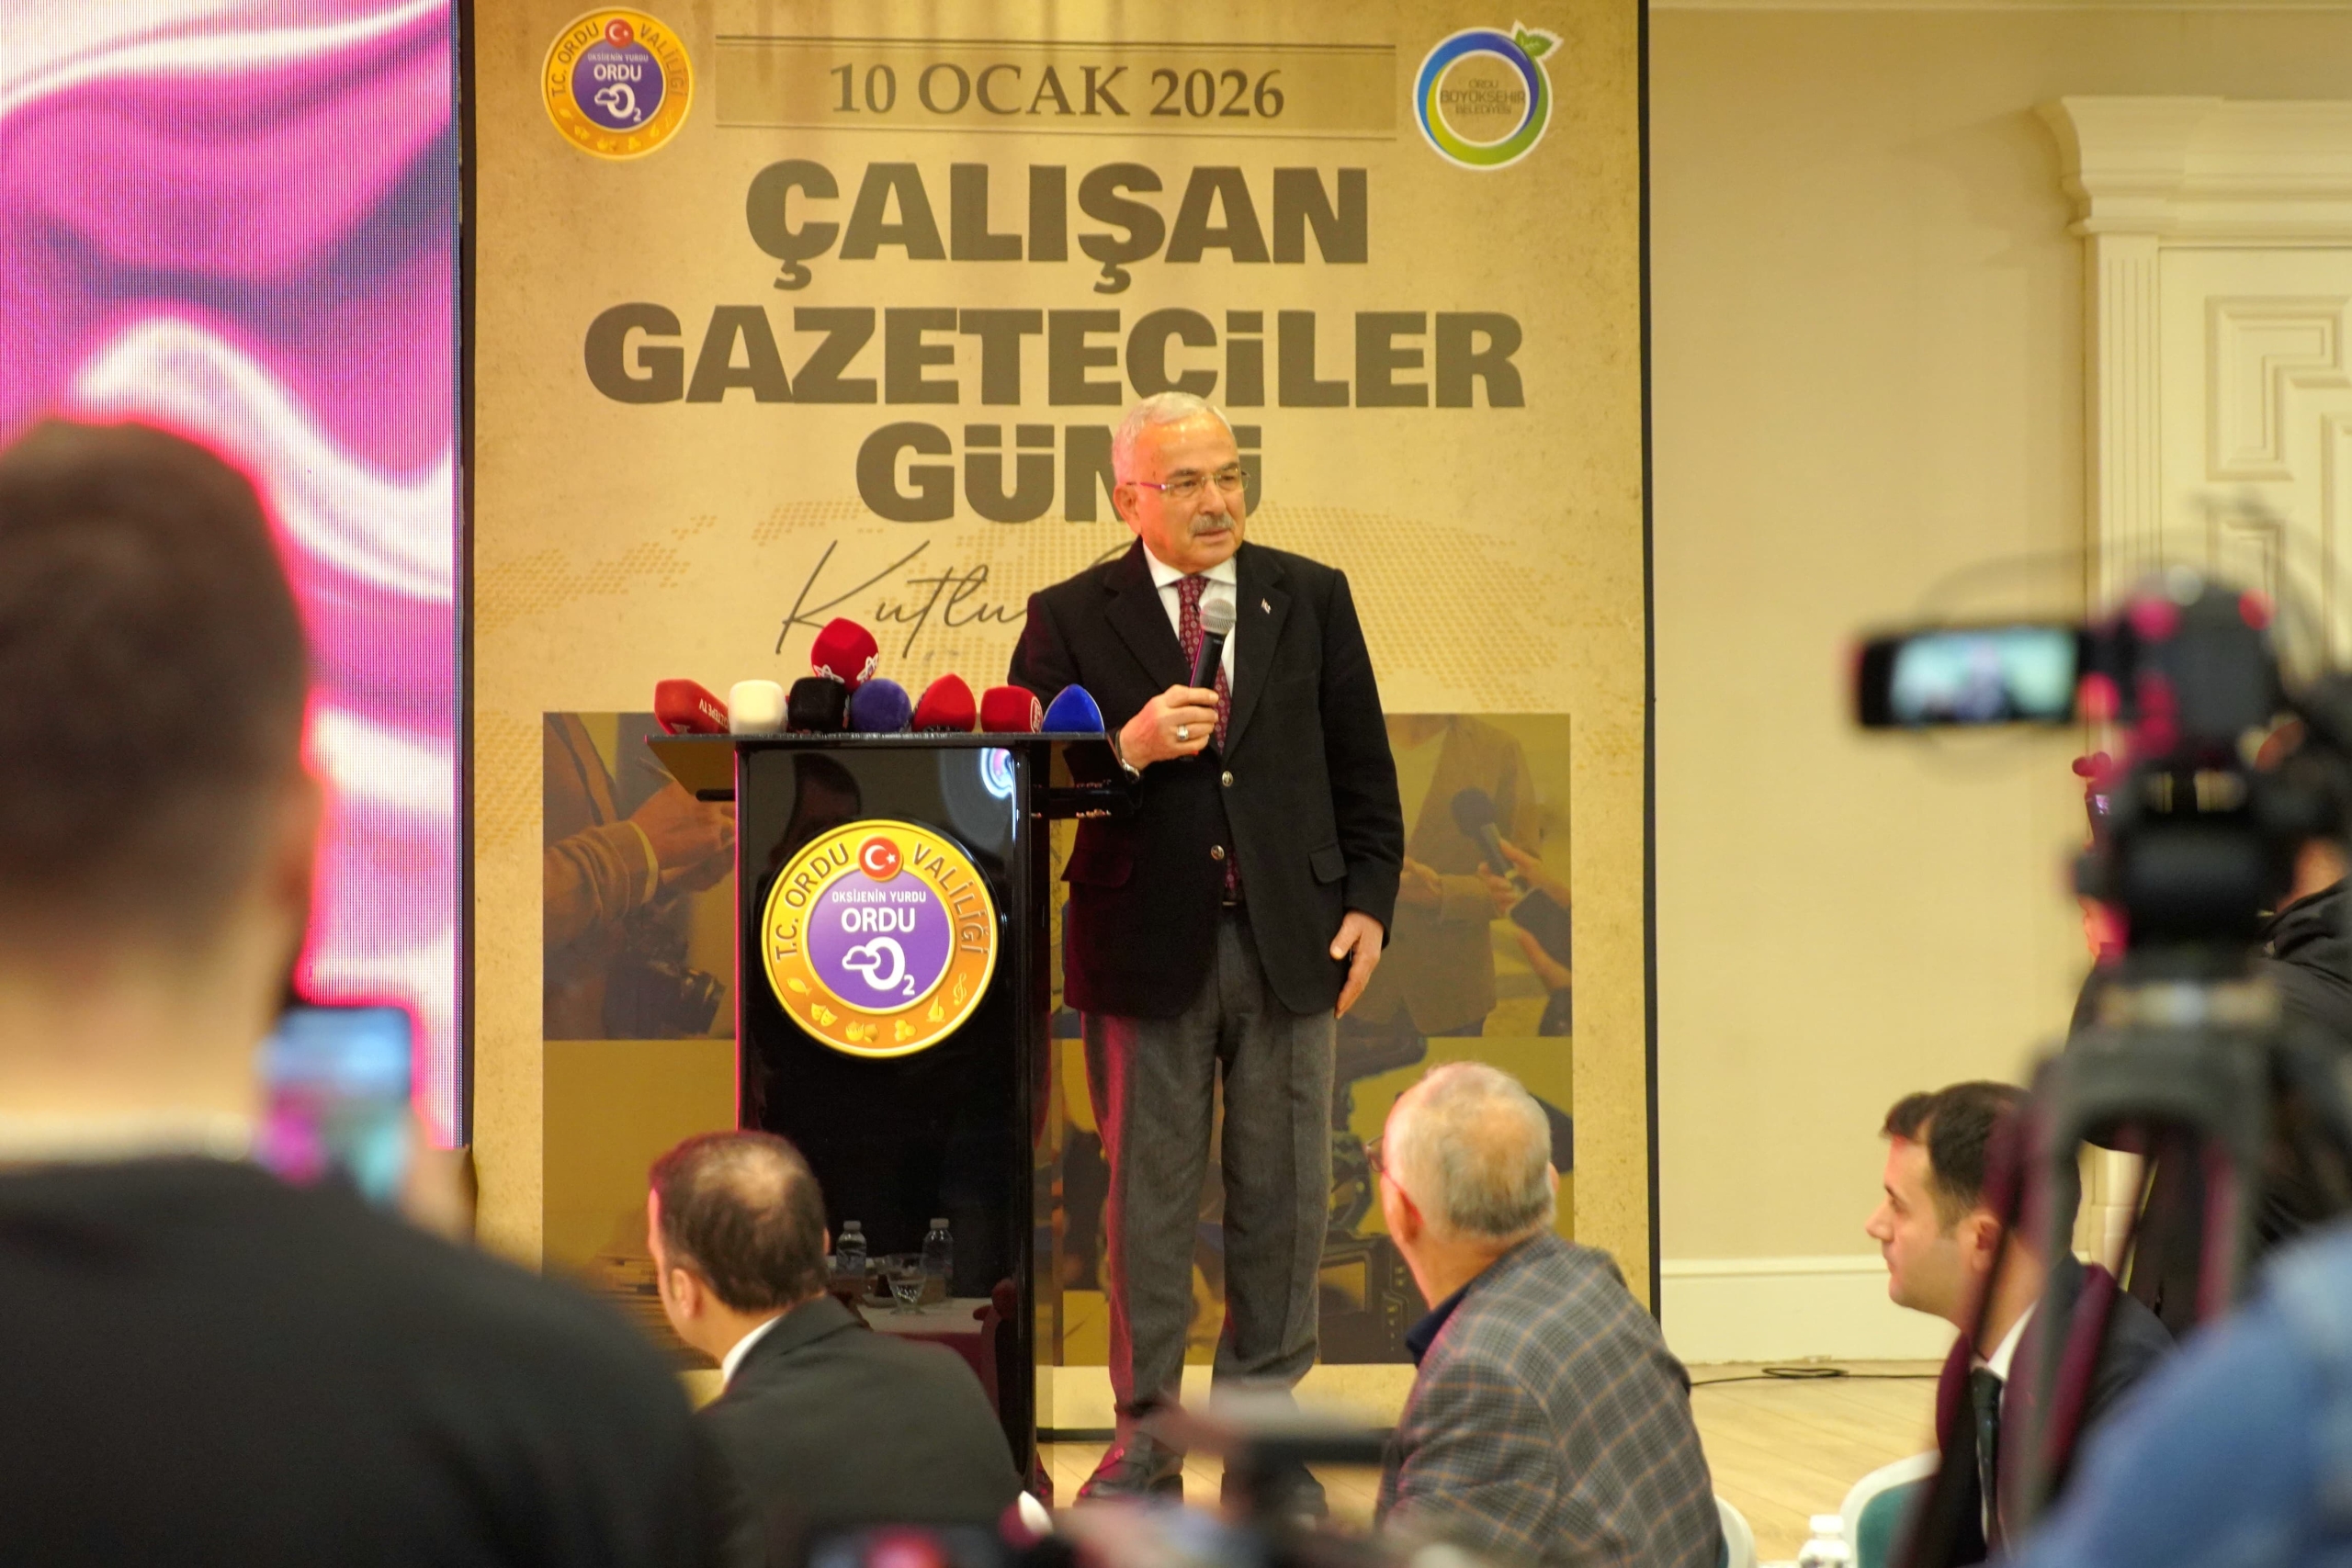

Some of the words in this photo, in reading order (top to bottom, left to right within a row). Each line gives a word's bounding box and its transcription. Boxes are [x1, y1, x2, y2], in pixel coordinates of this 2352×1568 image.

[557, 21, 599, 64] ORDU
[594, 63, 642, 82] ORDU
[831, 63, 897, 114] 10
[918, 63, 1130, 116] OCAK
[1149, 68, 1285, 118] 2026
[746, 159, 1369, 295] ÇALIŞAN
[584, 302, 1526, 408] GAZETECİLER
[855, 422, 1262, 524] GÜN
[785, 841, 849, 909] ORDU
[831, 888, 886, 904] OKSİJENİN
[890, 891, 927, 904] YURDU
[911, 842, 990, 955] VALİLİĞİ
[775, 917, 798, 962] T.C.
[841, 908, 916, 932] ORDU
